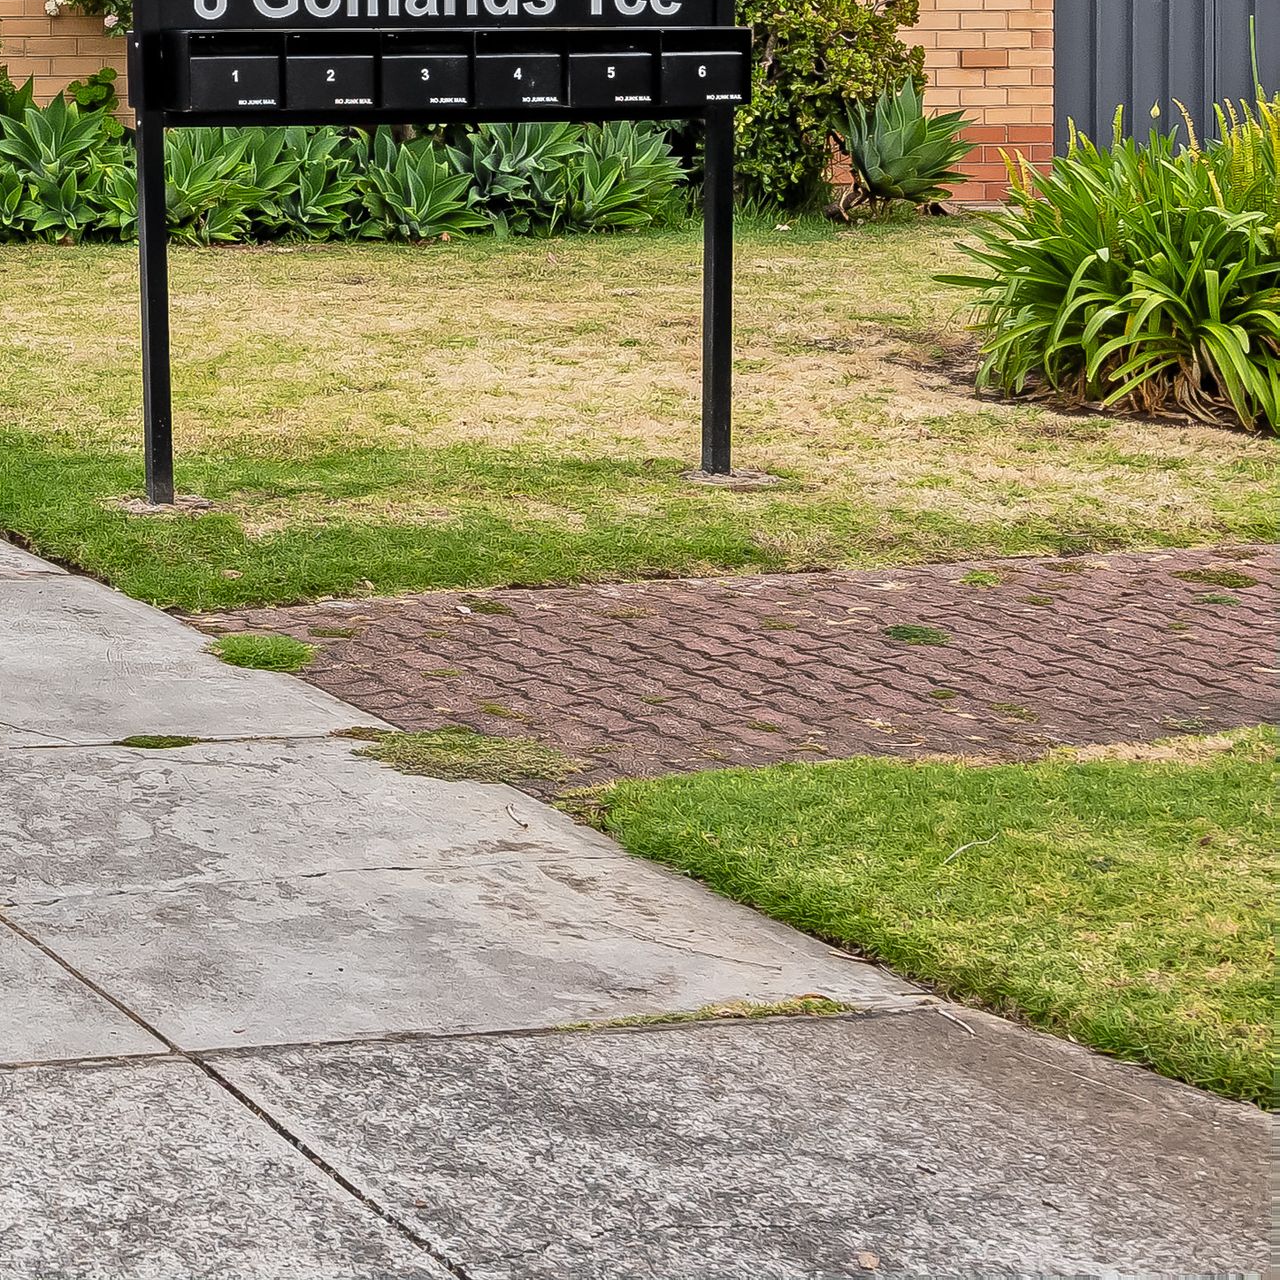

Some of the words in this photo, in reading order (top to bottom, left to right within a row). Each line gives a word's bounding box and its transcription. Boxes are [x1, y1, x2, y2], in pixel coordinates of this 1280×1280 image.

[231, 70, 239, 83] 1
[326, 69, 336, 82] 2
[421, 68, 430, 81] 3
[513, 67, 522, 80] 4
[607, 66, 616, 79] 5
[698, 65, 707, 78] 6
